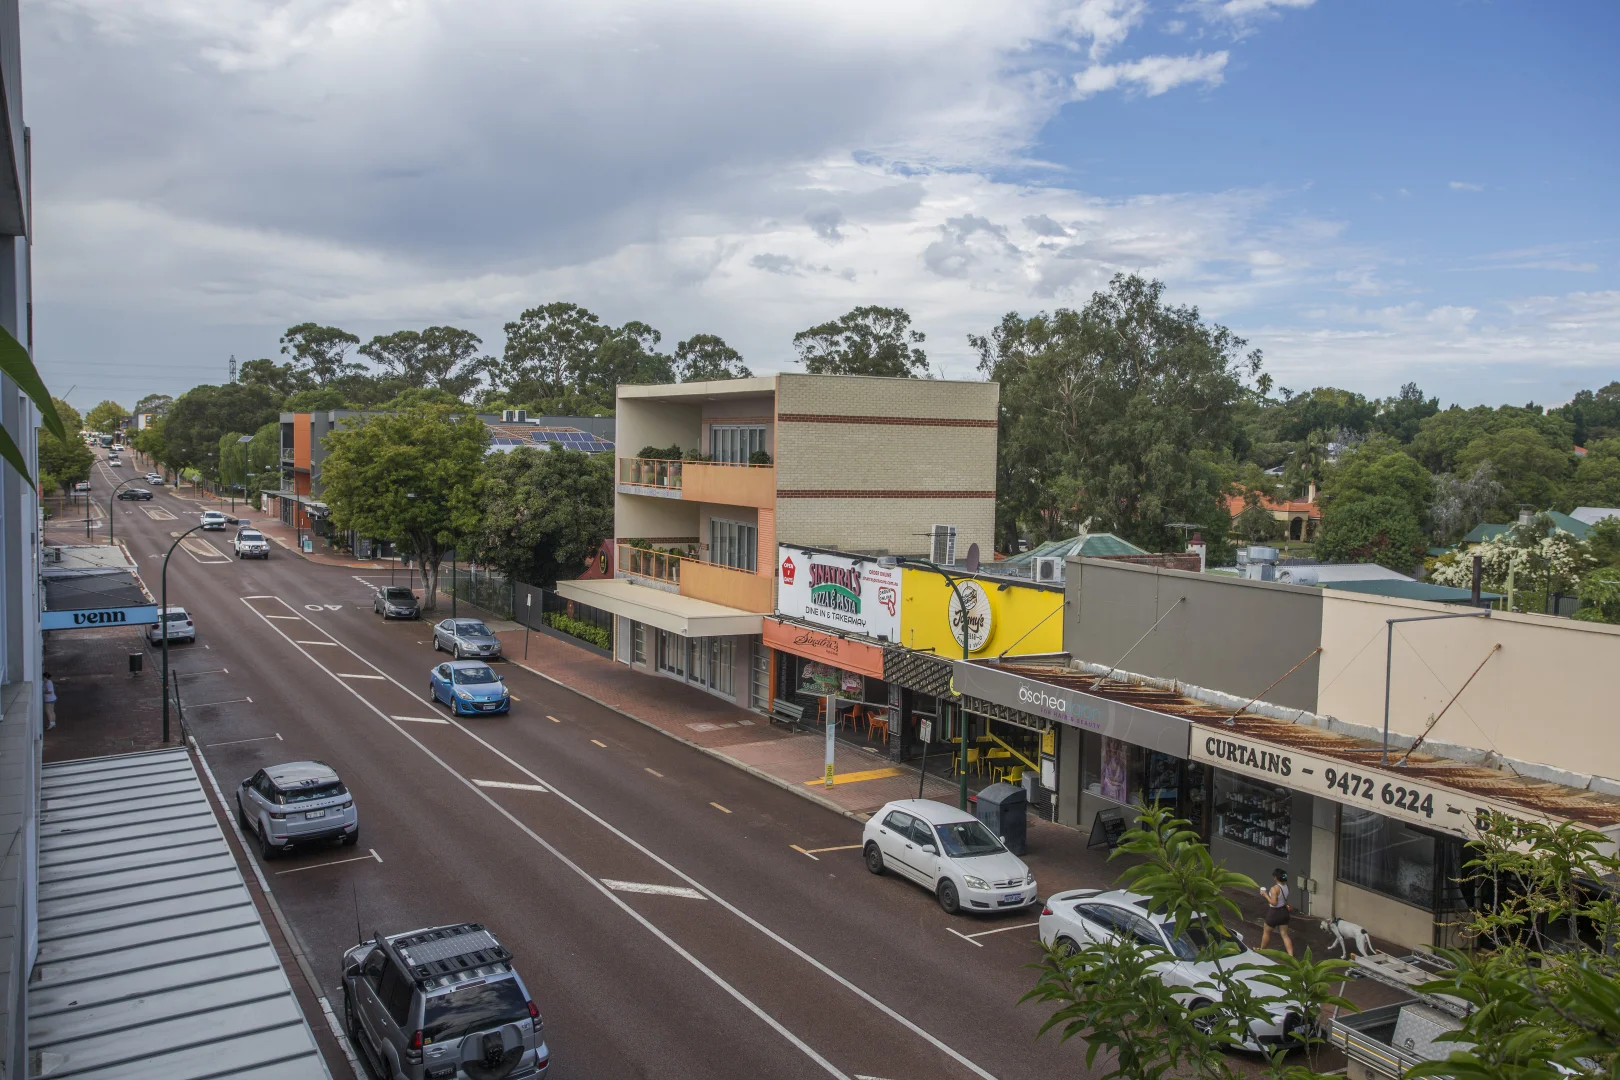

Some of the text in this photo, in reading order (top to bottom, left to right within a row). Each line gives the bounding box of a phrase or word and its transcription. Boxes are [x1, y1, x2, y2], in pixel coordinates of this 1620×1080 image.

[809, 563, 861, 597] SINATRA'S
[812, 588, 860, 614] PIZZA & PASTA
[73, 610, 127, 625] venn
[805, 605, 818, 617] DINE
[819, 609, 826, 618] IN
[832, 613, 867, 628] TAKEAWAY
[793, 631, 839, 653] Sinatra's
[1040, 707, 1051, 716] FOR
[1054, 712, 1068, 721] HAIR
[1077, 719, 1101, 729] BEAUTY
[1206, 737, 1292, 776] CURTAINS
[1325, 767, 1375, 801] 9472
[1380, 782, 1434, 819] 6224
